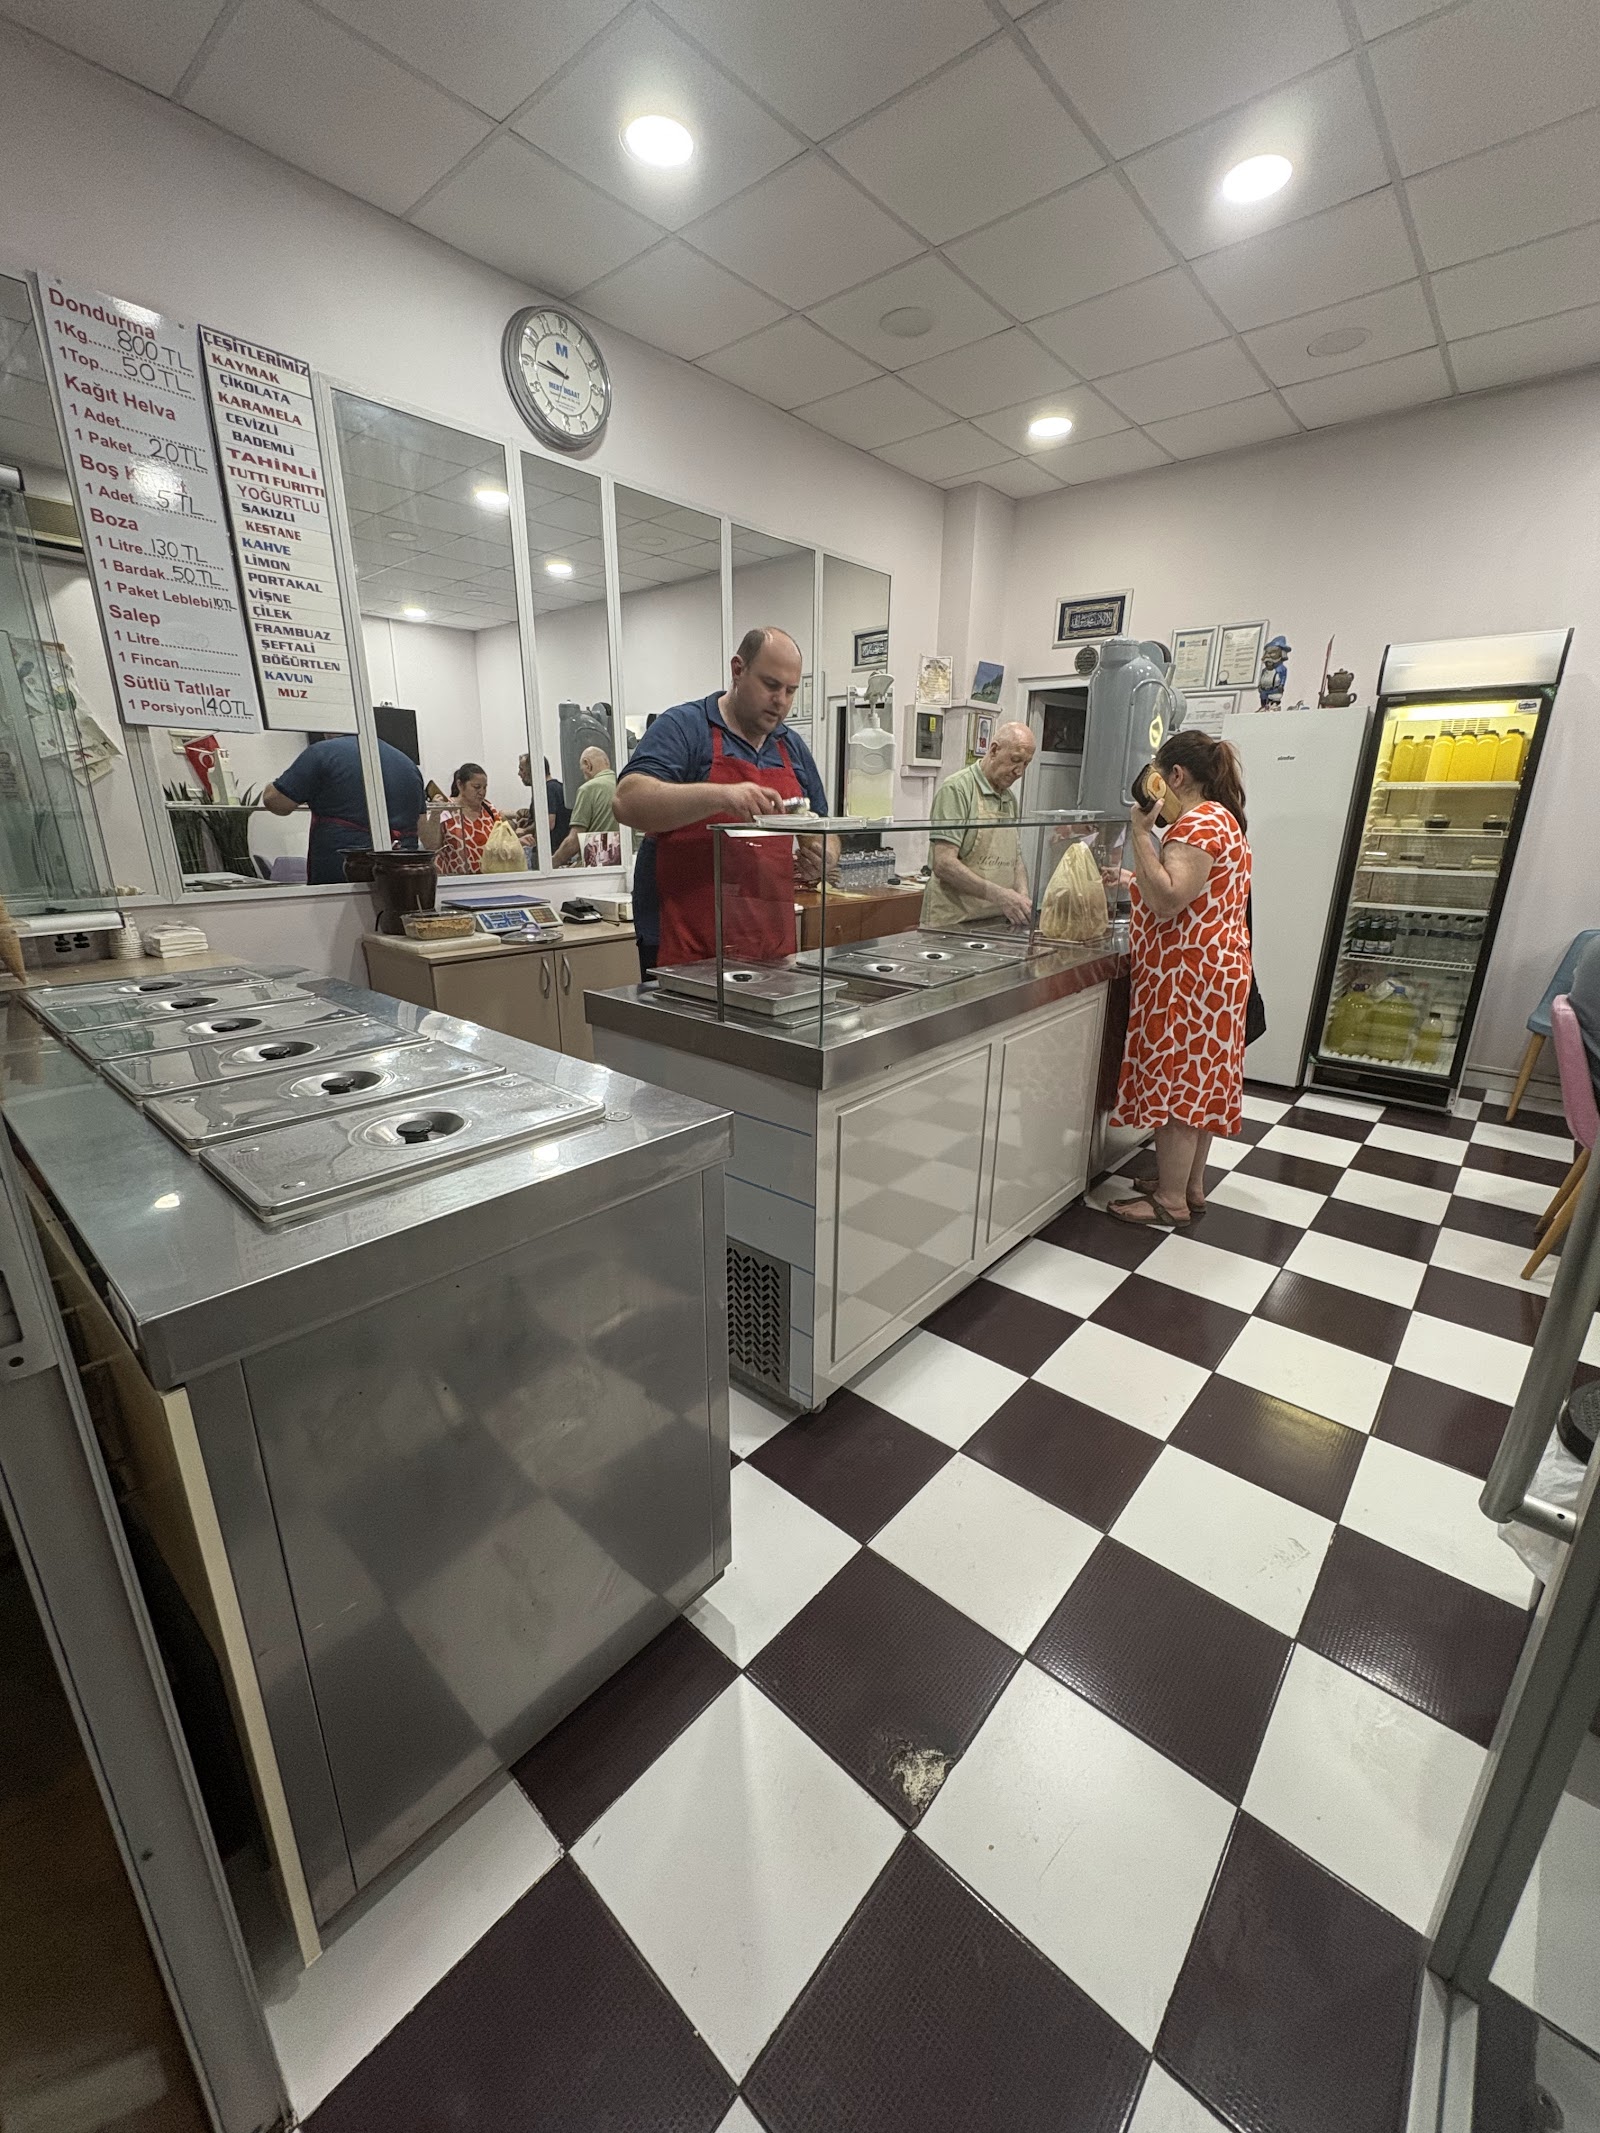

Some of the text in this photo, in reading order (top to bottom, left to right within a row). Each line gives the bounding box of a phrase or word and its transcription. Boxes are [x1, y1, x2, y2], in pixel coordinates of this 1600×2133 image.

[49, 288, 155, 340] Dondurma
[117, 330, 158, 360] 800
[161, 346, 193, 372] TL
[555, 341, 569, 359] M
[122, 356, 155, 381] 50
[158, 368, 191, 394] TL
[211, 352, 280, 385] KAYMAK
[64, 373, 176, 421] Kağıt Helva
[219, 373, 291, 405] ÇİKOLATA
[70, 403, 78, 416] 1
[217, 391, 303, 427] KARAMELA
[75, 428, 83, 440] 1
[225, 411, 279, 437] CEVİZLİ
[231, 429, 295, 457] BADEMLİ
[80, 454, 120, 480] Boş
[225, 446, 318, 481] TAHİNLİ
[85, 483, 93, 494] 1
[156, 489, 170, 508] 5
[174, 492, 204, 516] TL
[236, 482, 321, 515] YOĞURTLU
[90, 508, 139, 531] Boza
[240, 501, 296, 523] SAKIZLI
[244, 519, 303, 542] KESTANE
[95, 535, 103, 546] 1
[151, 538, 179, 558] 130
[181, 543, 208, 563] TL
[241, 536, 292, 556] KAHVE
[100, 558, 108, 569] 1
[243, 553, 291, 572] LİMON
[247, 571, 324, 594] PORTAKAL
[104, 581, 112, 591] 1
[117, 583, 159, 601] Paket
[163, 590, 213, 610] Leblebi
[247, 588, 292, 605] VİŞNE
[109, 604, 161, 628] Salep
[252, 603, 293, 621] ÇİLEK
[114, 630, 122, 641] 1
[254, 621, 332, 641] FRAMBUAZ
[118, 652, 127, 663] 1
[261, 638, 316, 655] ŞEFTALİ
[261, 653, 341, 672] BÖĞÜRTLEN
[123, 674, 231, 698] Sütlü Tatlılar
[264, 669, 314, 684] KAVUN
[128, 699, 137, 710] 1
[277, 686, 309, 700] MUZ
